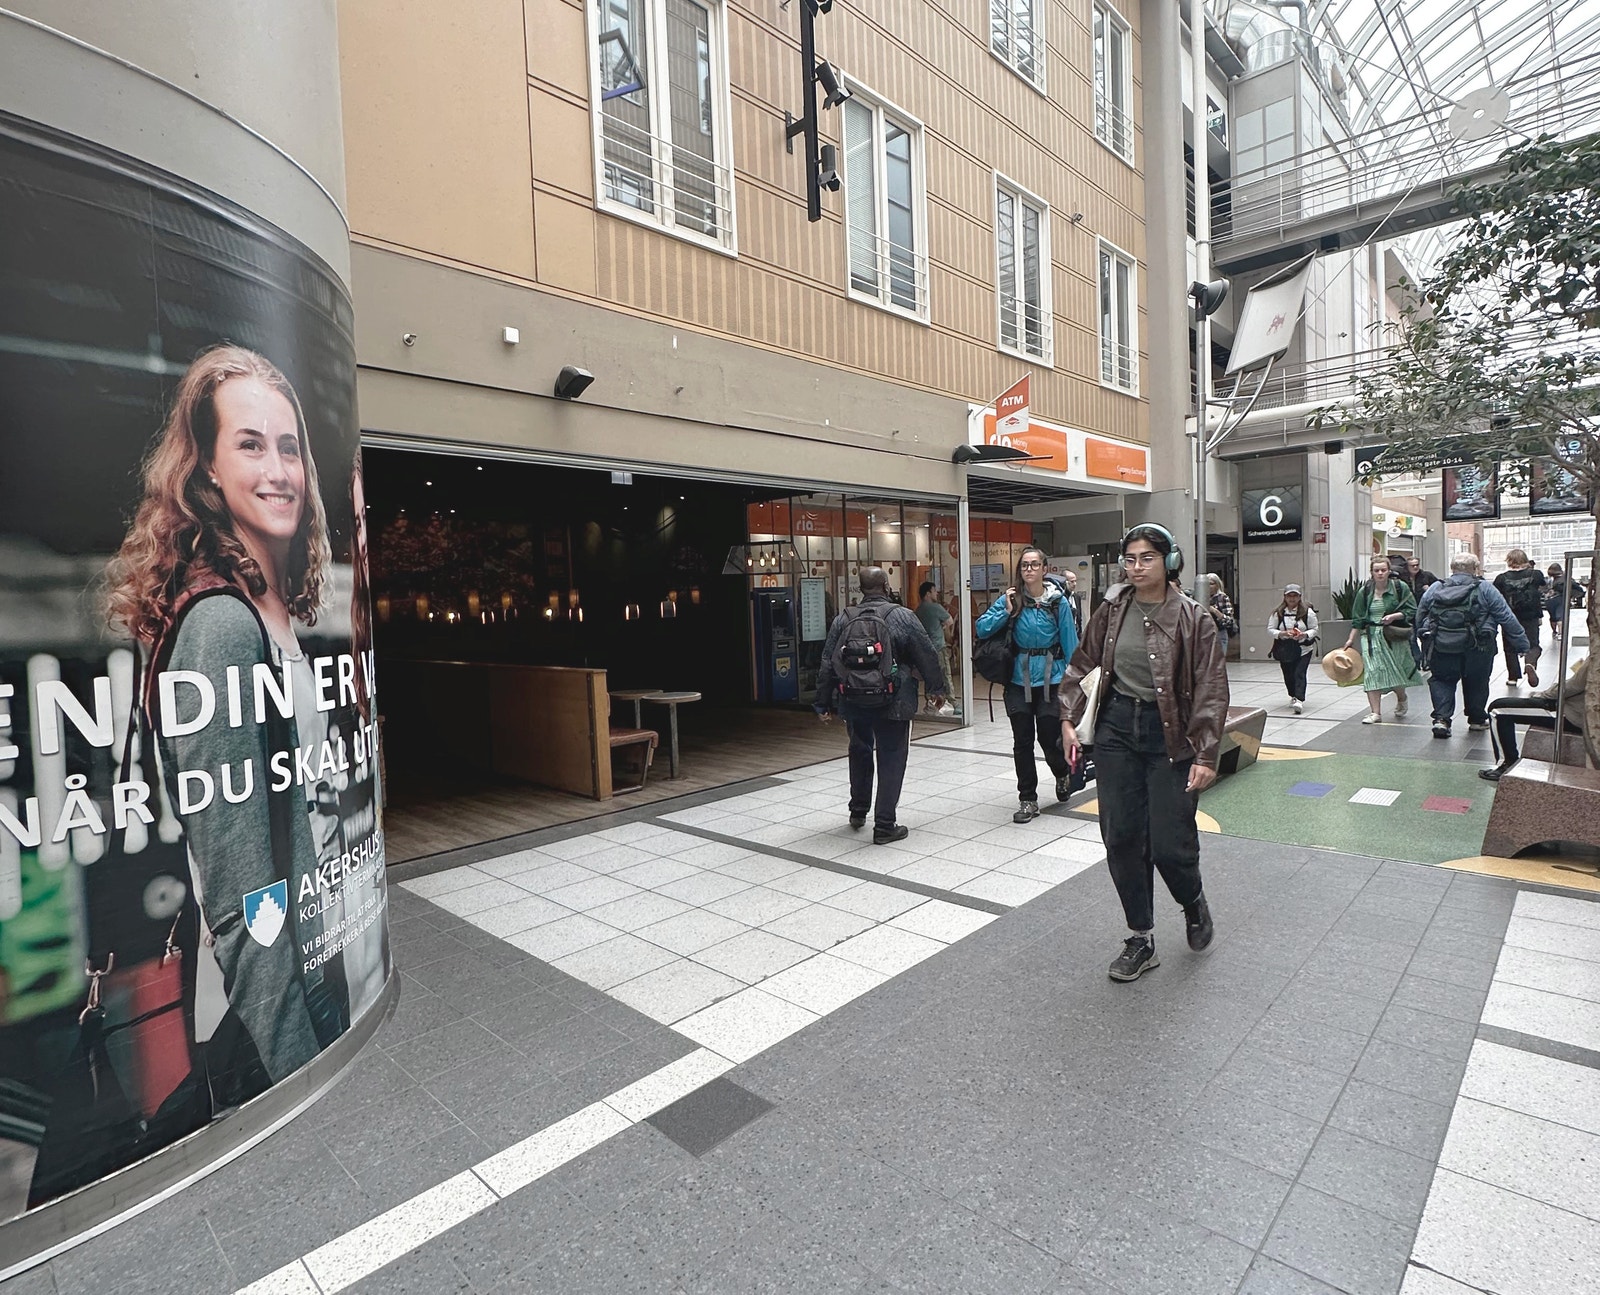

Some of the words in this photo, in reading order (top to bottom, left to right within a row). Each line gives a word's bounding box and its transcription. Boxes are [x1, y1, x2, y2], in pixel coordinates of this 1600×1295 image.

[1002, 395, 1024, 408] ATM
[1442, 457, 1463, 465] 10-14
[796, 514, 814, 531] ria
[1260, 495, 1283, 527] 6
[934, 523, 948, 536] ria
[763, 576, 777, 587] ria
[158, 660, 294, 738] DIN
[314, 654, 358, 712] ER
[0, 773, 155, 848] NÅR
[177, 758, 255, 816] DU
[270, 736, 350, 793] SKAL
[297, 829, 380, 904] AKERSHUS
[302, 940, 313, 956] VI
[315, 920, 346, 949] BIDRAR
[303, 927, 359, 975] FORETREKKER
